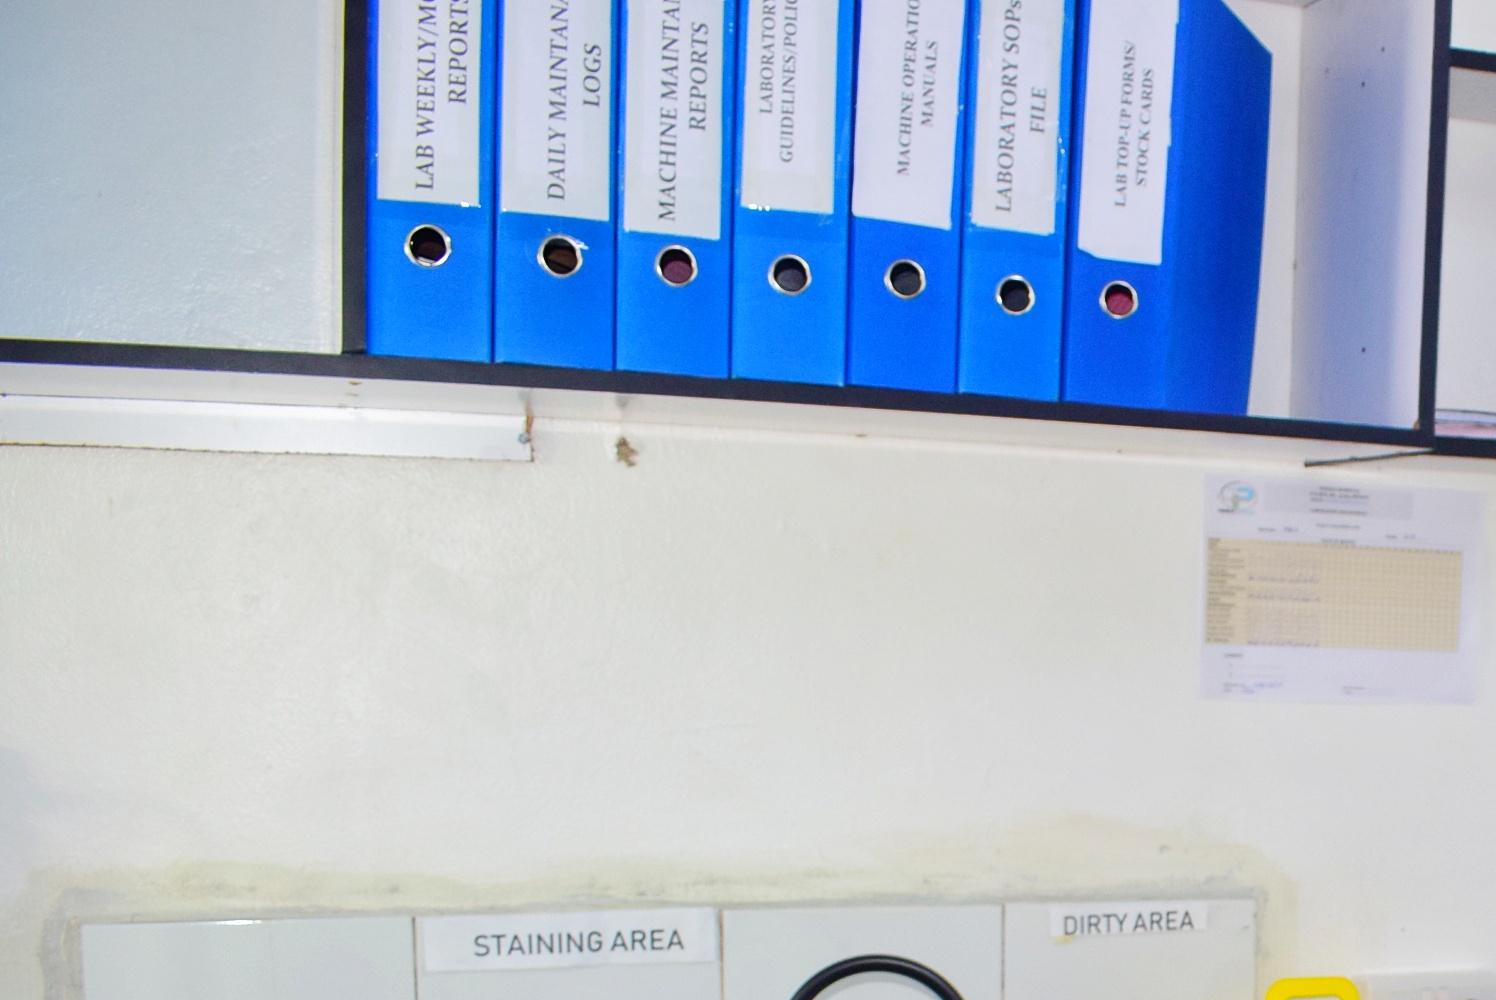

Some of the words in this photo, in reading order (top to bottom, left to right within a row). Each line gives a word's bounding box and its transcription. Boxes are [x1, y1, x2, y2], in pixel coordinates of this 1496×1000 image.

[583, 43, 602, 108] LOGS
[660, 0, 681, 101] MAINTA
[688, 22, 709, 131] REPORTS
[1121, 40, 1136, 106] FORMS/
[921, 40, 938, 127] MANUALS
[1030, 86, 1048, 134] FILE
[1139, 67, 1154, 125] CARDS
[547, 127, 567, 201] DAILY
[657, 107, 678, 222] MACHINE
[897, 91, 915, 176] MACHINE
[996, 59, 1020, 213] LABORATORY
[1117, 108, 1131, 169] TOP-UP
[1136, 130, 1150, 187] STOCK
[415, 144, 435, 191] LAB
[1114, 174, 1127, 207] LAB
[473, 930, 603, 957] STAINING
[610, 928, 685, 951] AREA
[1063, 911, 1128, 936] DIRTY
[1132, 909, 1195, 933] AREA
